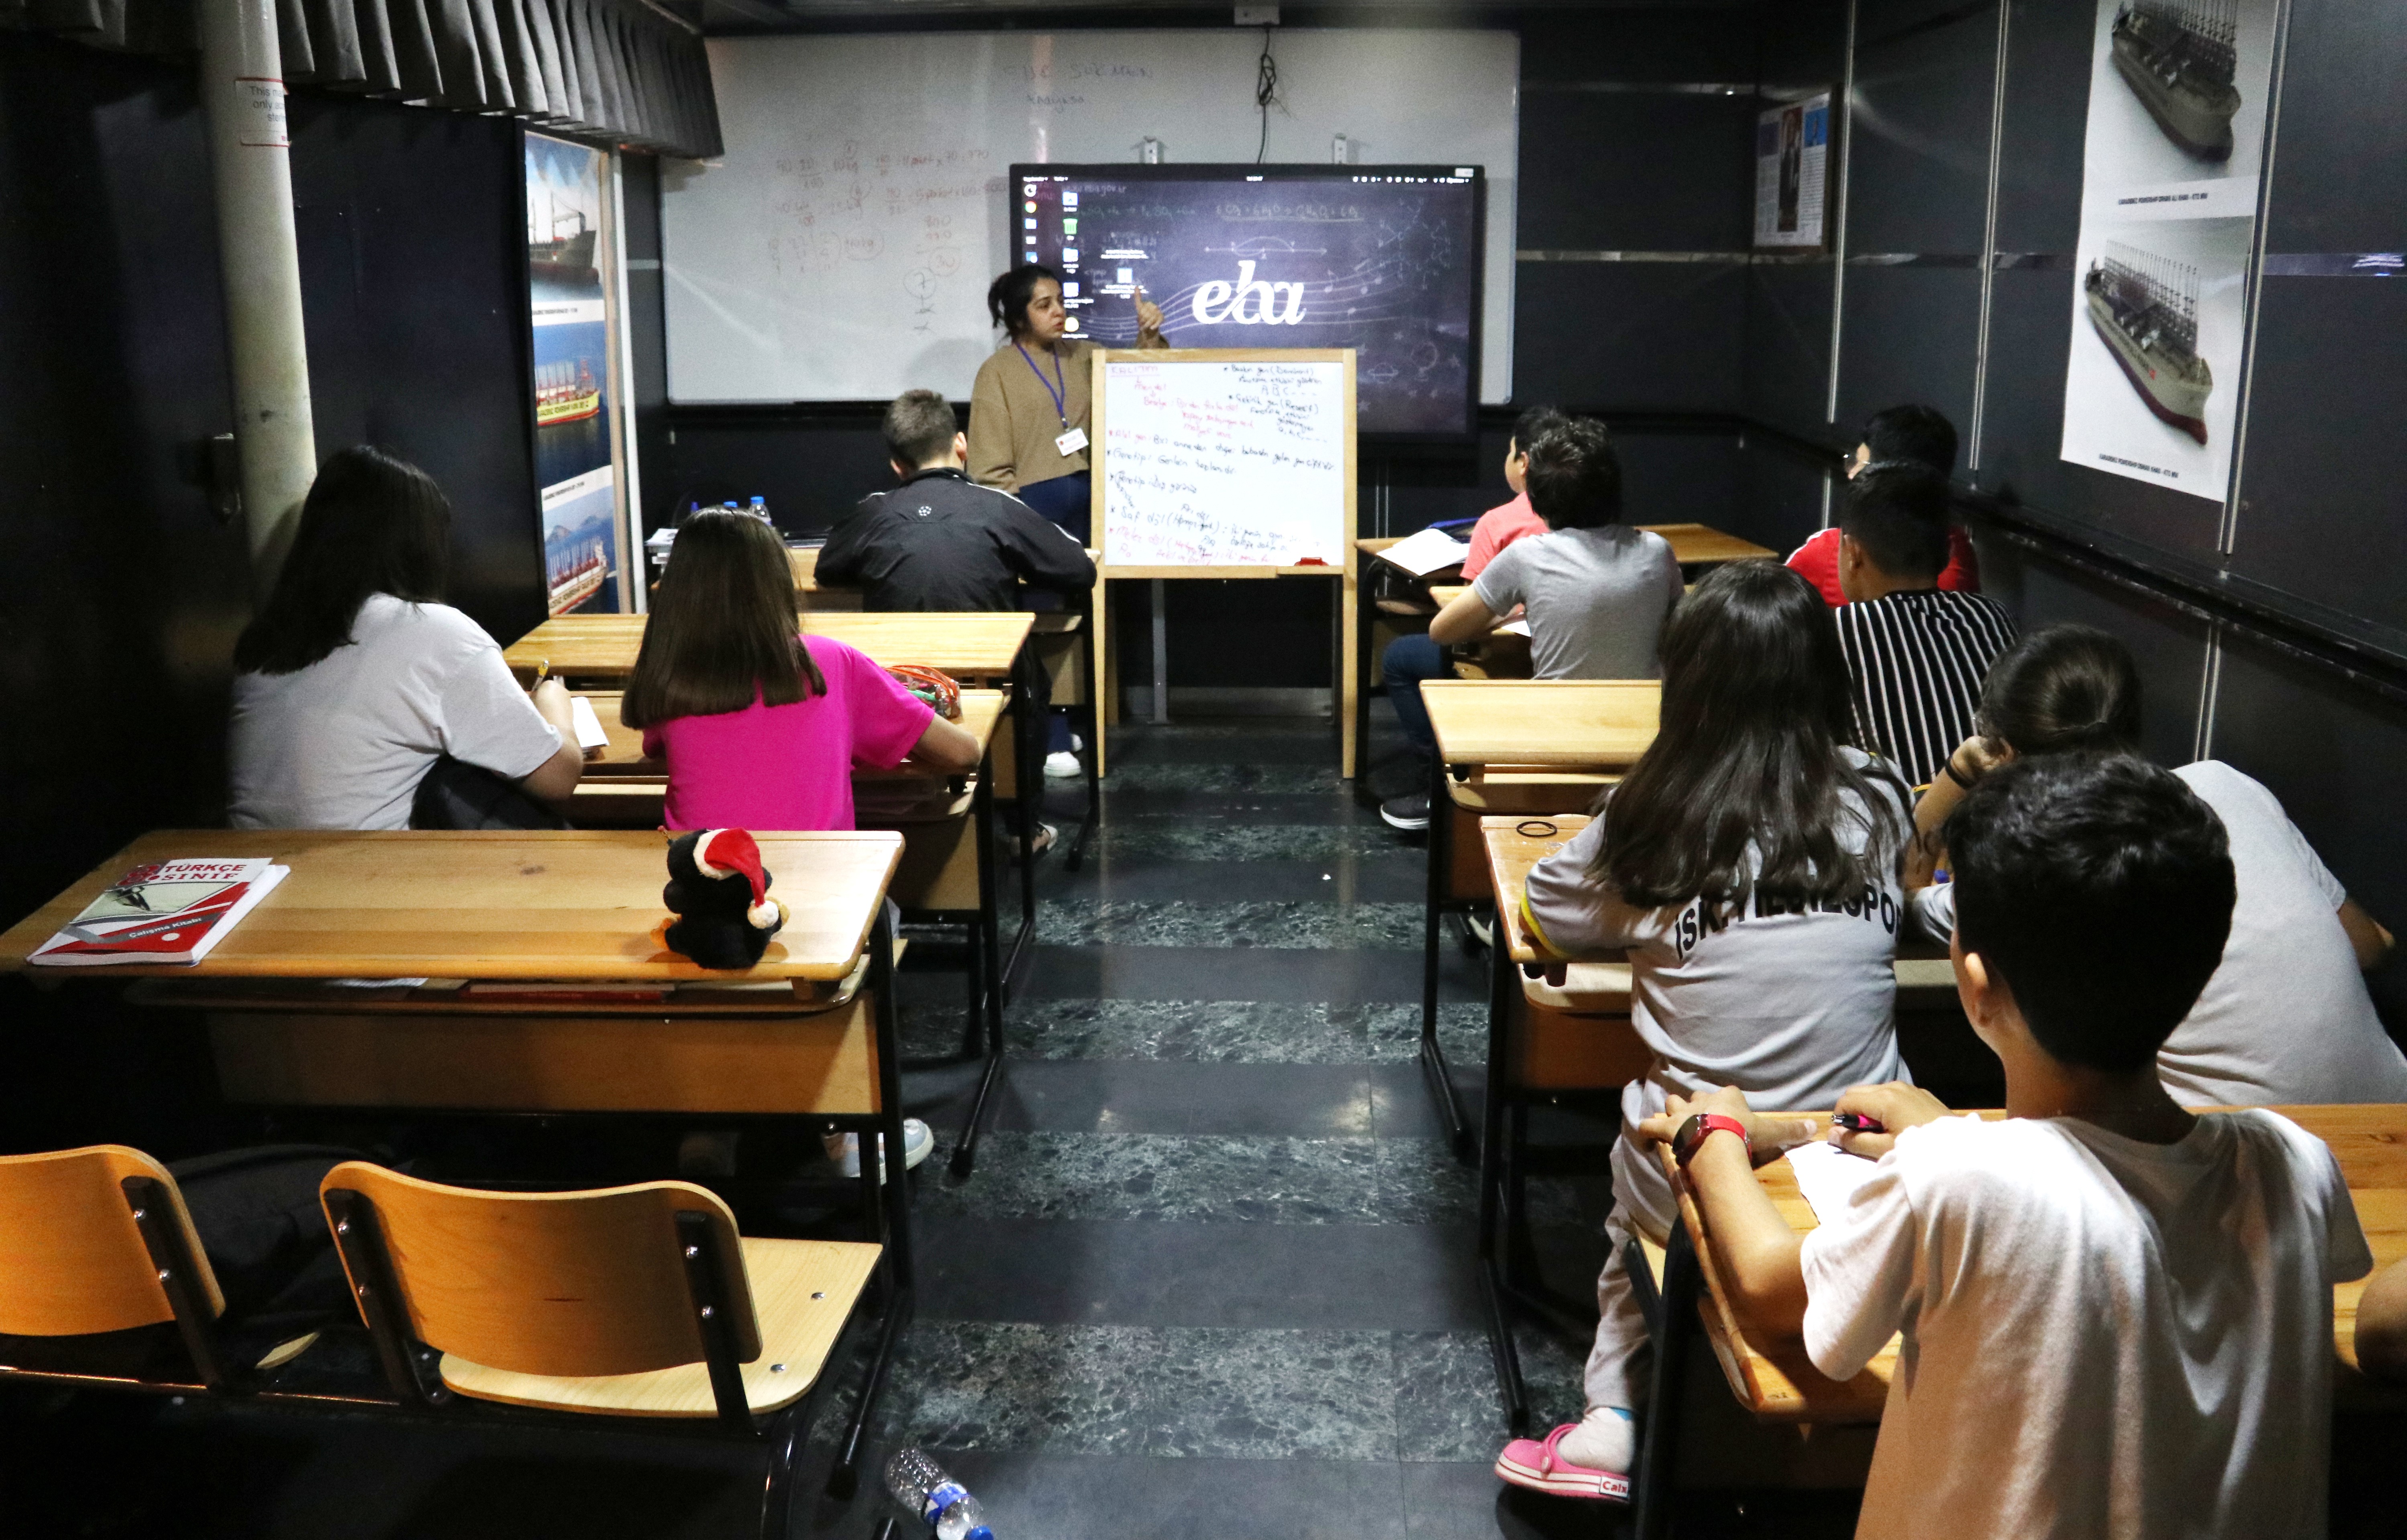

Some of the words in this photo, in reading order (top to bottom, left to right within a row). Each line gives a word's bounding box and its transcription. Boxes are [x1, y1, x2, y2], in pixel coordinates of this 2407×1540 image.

[250, 86, 270, 96] This
[253, 99, 272, 111] only
[1193, 260, 1308, 325] eba
[164, 863, 247, 873] TÜRKÇE
[161, 872, 240, 881] SINIF
[129, 925, 170, 938] Çalışma
[172, 917, 202, 928] Kitabı
